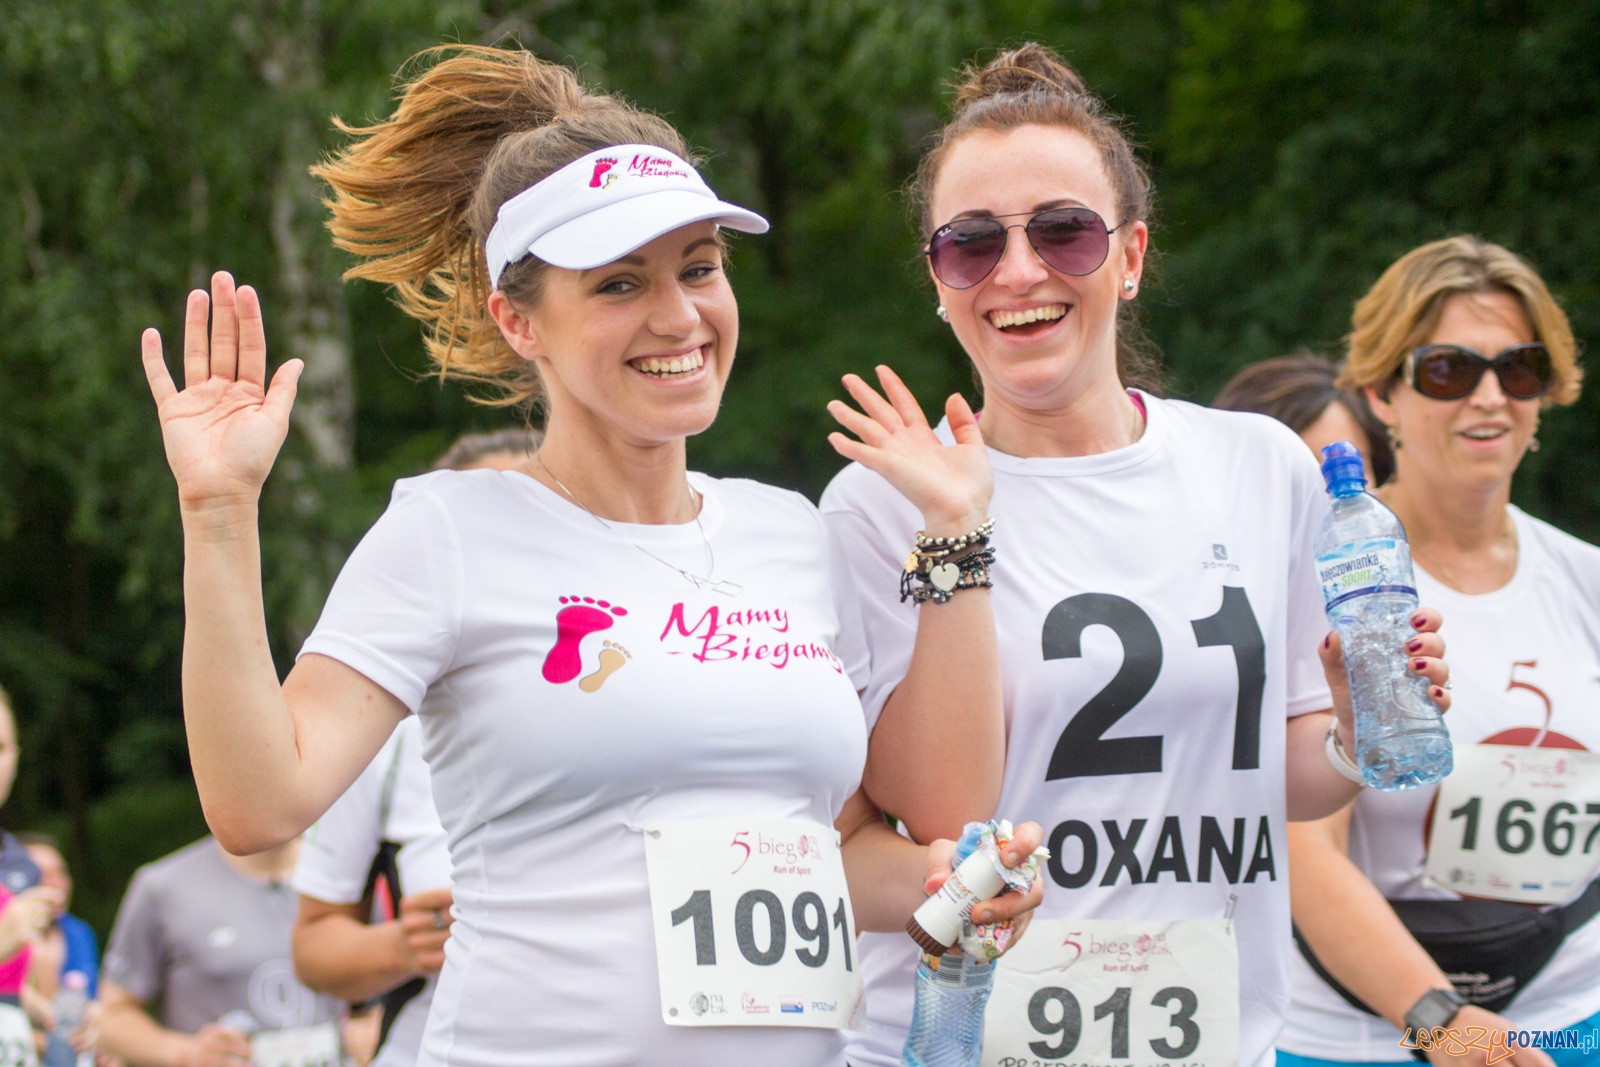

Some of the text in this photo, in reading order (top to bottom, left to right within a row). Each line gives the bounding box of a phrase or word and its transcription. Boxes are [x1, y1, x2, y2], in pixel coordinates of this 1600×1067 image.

[660, 602, 788, 642] Mamy
[692, 633, 842, 674] Biegamy
[1041, 585, 1267, 782] 21
[1450, 796, 1600, 858] 1667
[730, 831, 751, 875] 5
[758, 832, 797, 864] bieg
[773, 865, 812, 877] Run of Spirit
[1047, 815, 1276, 890] OXANA
[670, 889, 853, 972] 1091
[1060, 932, 1082, 972] 5
[1089, 934, 1132, 962] bieg
[1103, 963, 1149, 973] Run of Spirit
[1028, 986, 1200, 1060] 913
